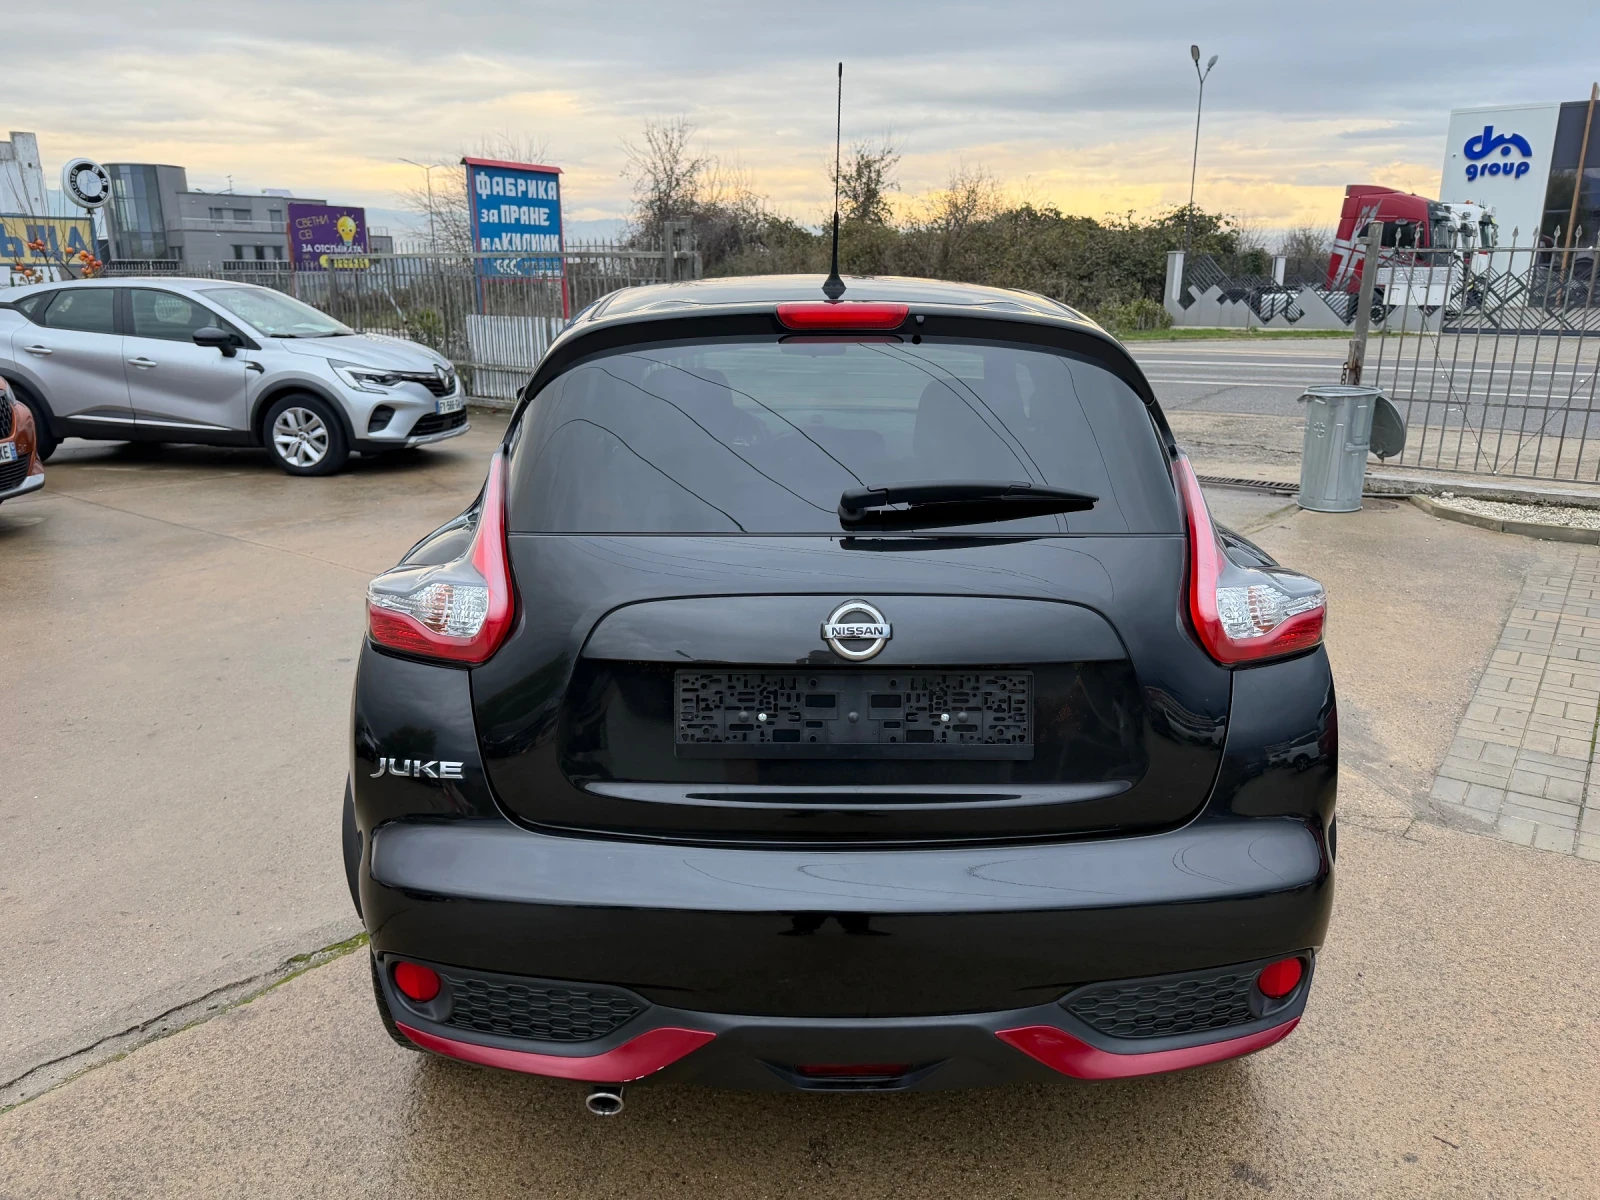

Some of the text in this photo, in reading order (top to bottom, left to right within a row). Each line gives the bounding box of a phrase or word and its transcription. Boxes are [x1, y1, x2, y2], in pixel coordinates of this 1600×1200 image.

[1465, 161, 1530, 182] group
[475, 172, 558, 200] ФАБРИКА
[500, 204, 550, 227] ПРАНЕ
[301, 244, 313, 253] ЗА
[832, 626, 884, 635] NISSAN
[370, 757, 464, 779] JUKE
